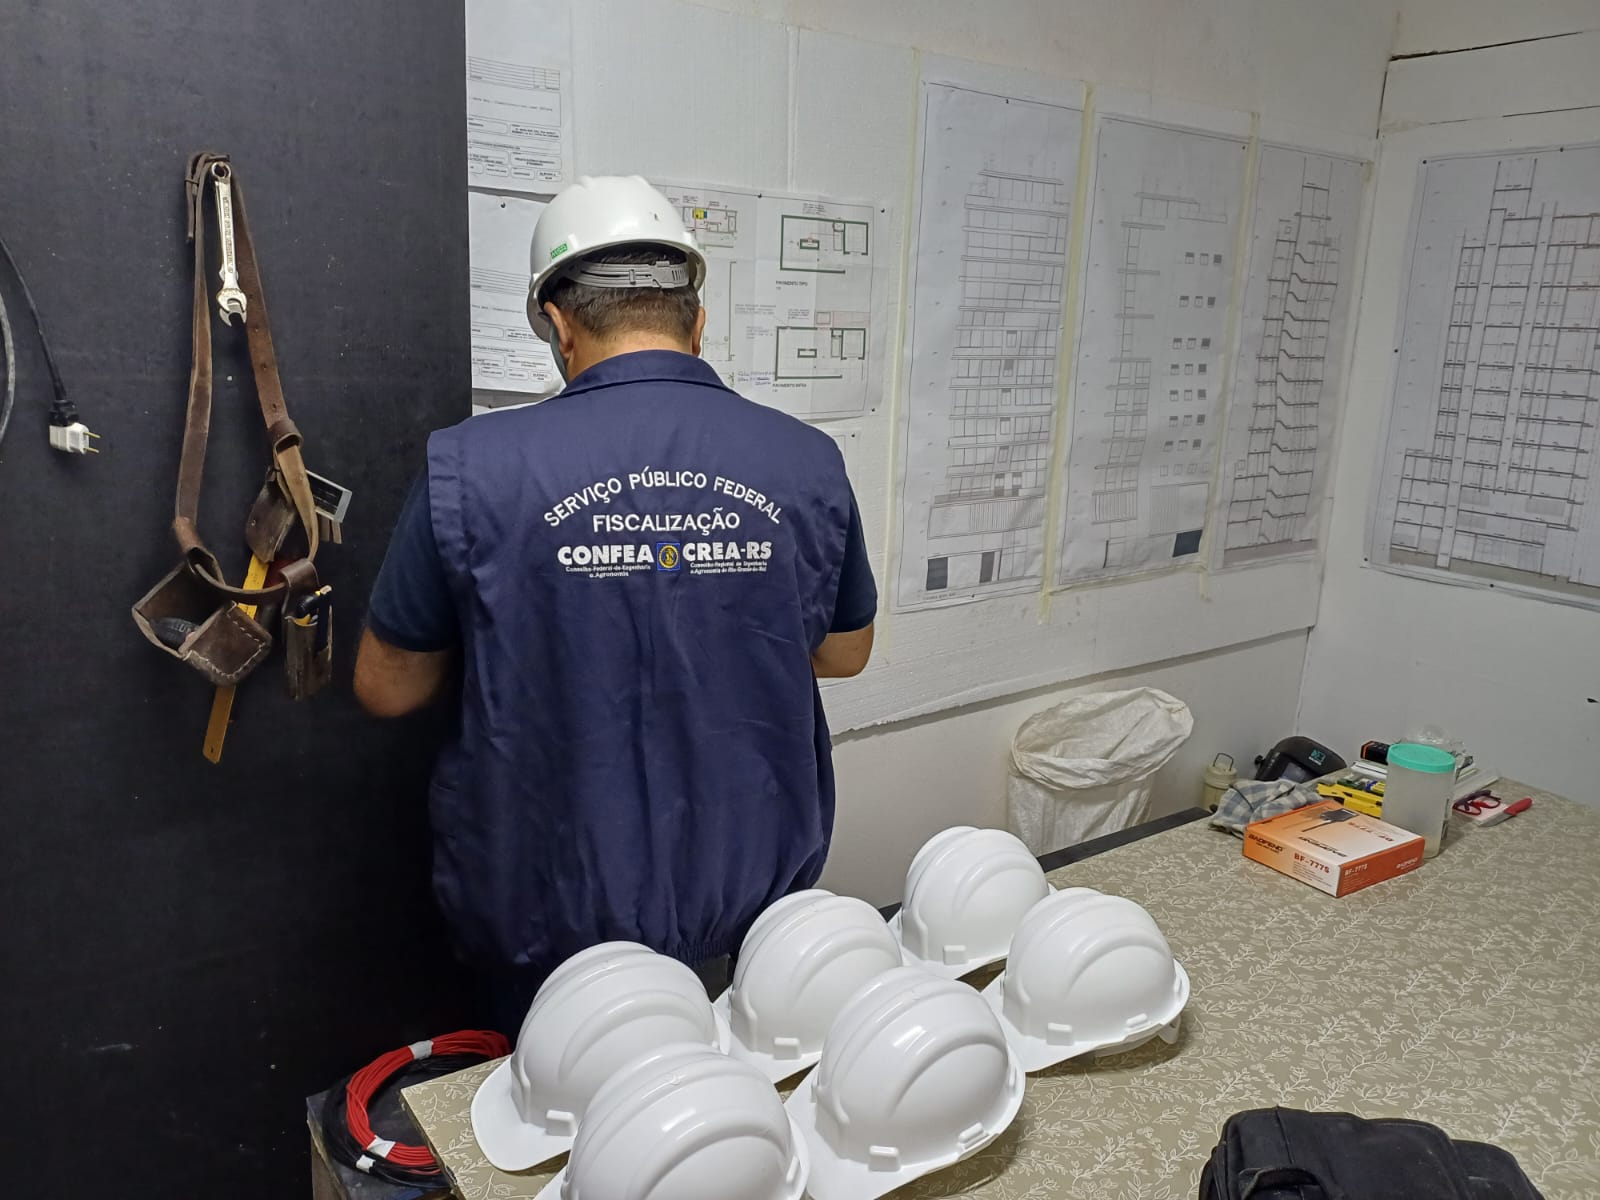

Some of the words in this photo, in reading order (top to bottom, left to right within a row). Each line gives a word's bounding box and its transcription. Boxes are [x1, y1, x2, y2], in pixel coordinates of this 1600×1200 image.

[543, 477, 622, 527] SERVIÇO
[628, 466, 707, 490] PÚBLICO
[713, 476, 783, 525] FEDERAL
[592, 507, 741, 536] FISCALIZAÇÃO
[557, 544, 655, 566] CONFEA
[682, 541, 773, 562] CREA-RS
[1294, 852, 1330, 874] BF-777S
